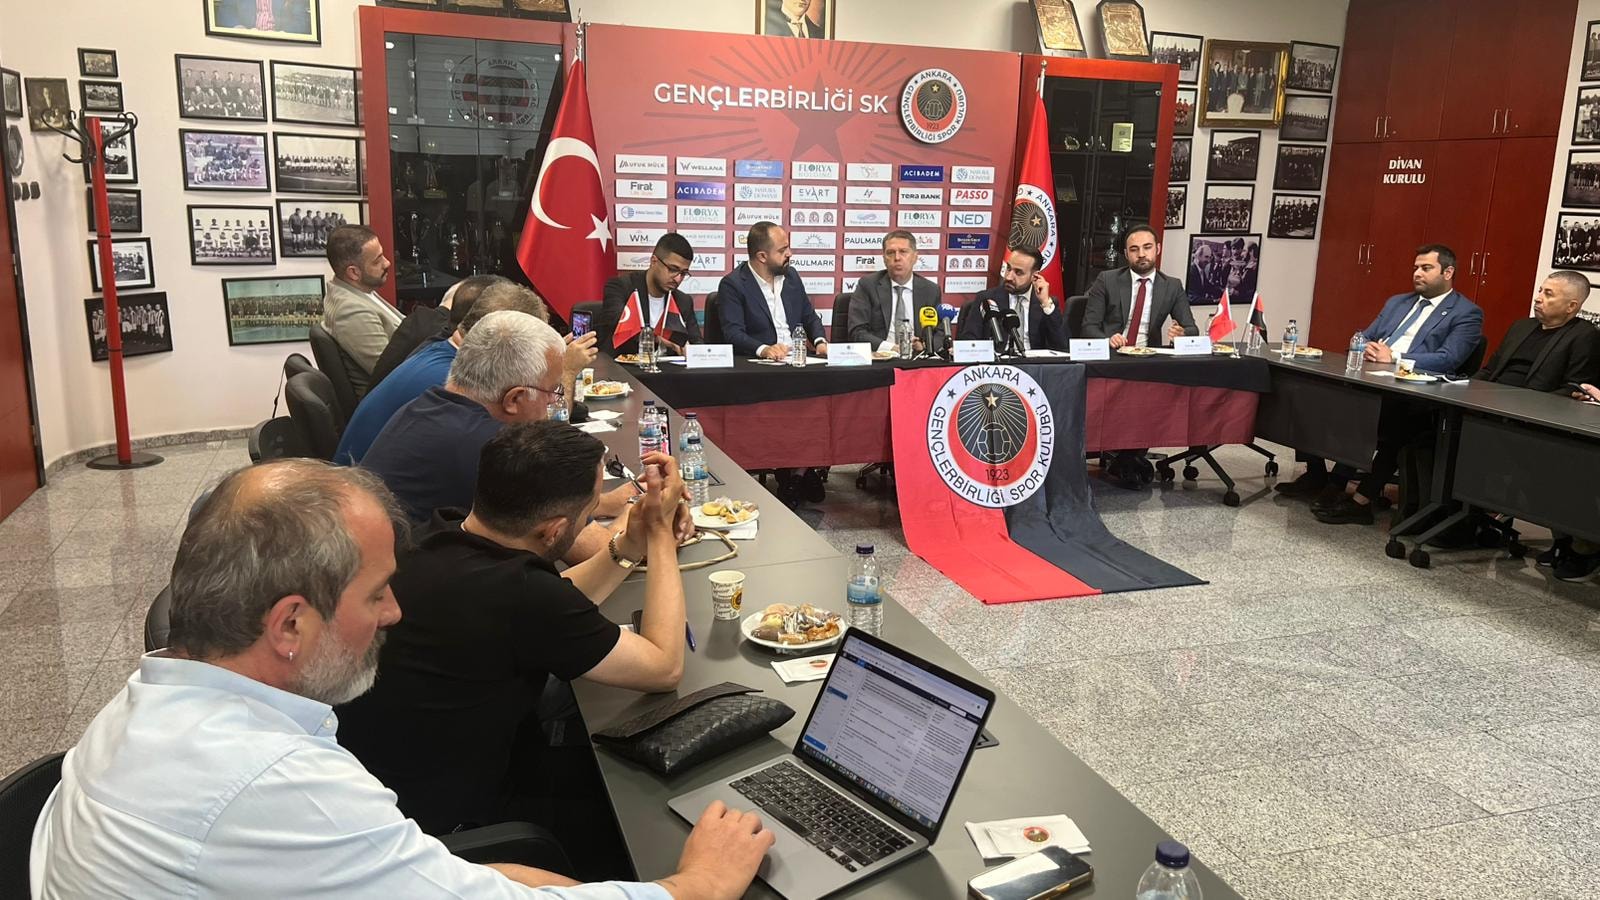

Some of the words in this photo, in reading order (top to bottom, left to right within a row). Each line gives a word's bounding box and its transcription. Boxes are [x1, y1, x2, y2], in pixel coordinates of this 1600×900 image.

[920, 71, 952, 82] ANKARA
[654, 82, 853, 112] GENÇLERBİRLİĞİ
[860, 95, 888, 114] SK
[937, 124, 957, 140] SPOR
[799, 163, 832, 172] FLORYA
[1389, 156, 1423, 169] DİVAN
[1383, 173, 1426, 184] KURULU
[677, 186, 726, 195] ACIBADEM
[955, 190, 989, 200] PASSO
[683, 208, 719, 216] FLORYA
[903, 212, 936, 220] FLORYA
[1036, 194, 1056, 237] ANKARA
[954, 214, 985, 225] NED
[630, 234, 649, 242] WM
[963, 366, 1020, 386] ANKARA
[931, 406, 1006, 504] GENÇLERBİRLİĞİ
[1010, 469, 1043, 501] SPOR
[1035, 404, 1053, 467] KULÜBÜ
[985, 468, 1010, 481] 1923
